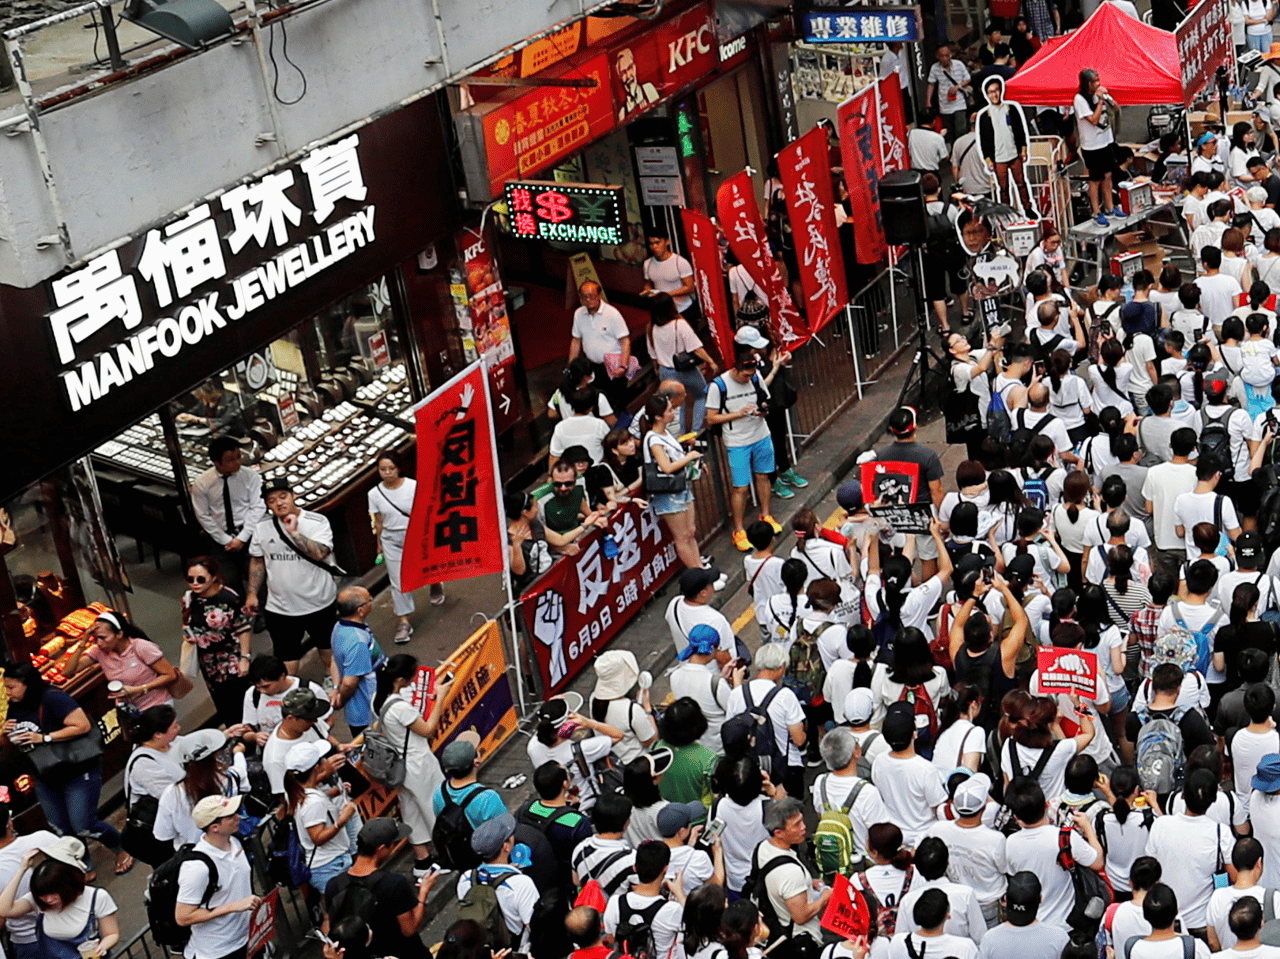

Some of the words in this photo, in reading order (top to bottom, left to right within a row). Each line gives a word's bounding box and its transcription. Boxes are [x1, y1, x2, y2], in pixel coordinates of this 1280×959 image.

[668, 23, 711, 74] KFC
[718, 35, 747, 62] lcome
[464, 240, 486, 263] KFC
[539, 222, 617, 242] EXCHANGE
[226, 205, 376, 321] JEWELLERY
[63, 291, 228, 412] MANFOOK
[568, 605, 613, 661] 6月9日
[615, 579, 639, 614] 3時
